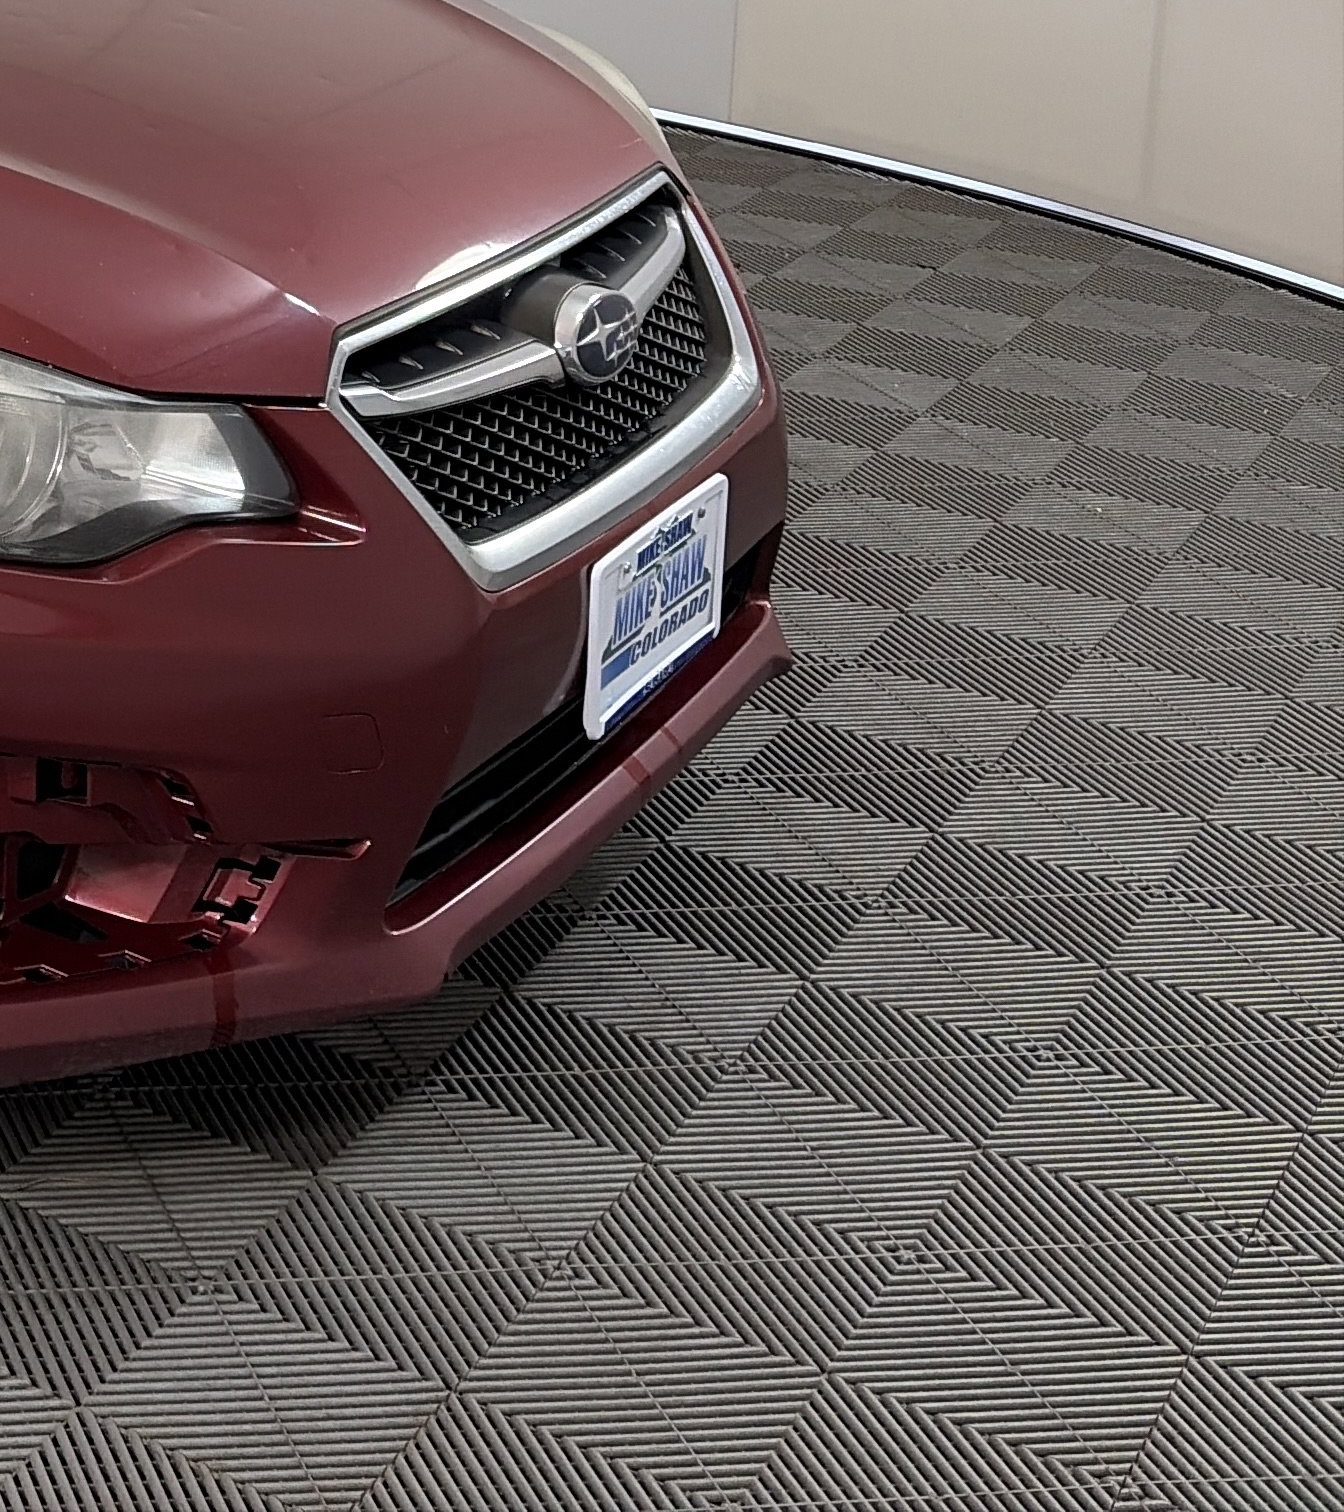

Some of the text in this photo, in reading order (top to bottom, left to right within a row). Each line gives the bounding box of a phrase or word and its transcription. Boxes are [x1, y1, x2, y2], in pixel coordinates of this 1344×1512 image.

[638, 515, 693, 570] MIKE SHAW
[613, 534, 707, 645] MIKE SHAW
[631, 589, 710, 666] COLORADO
